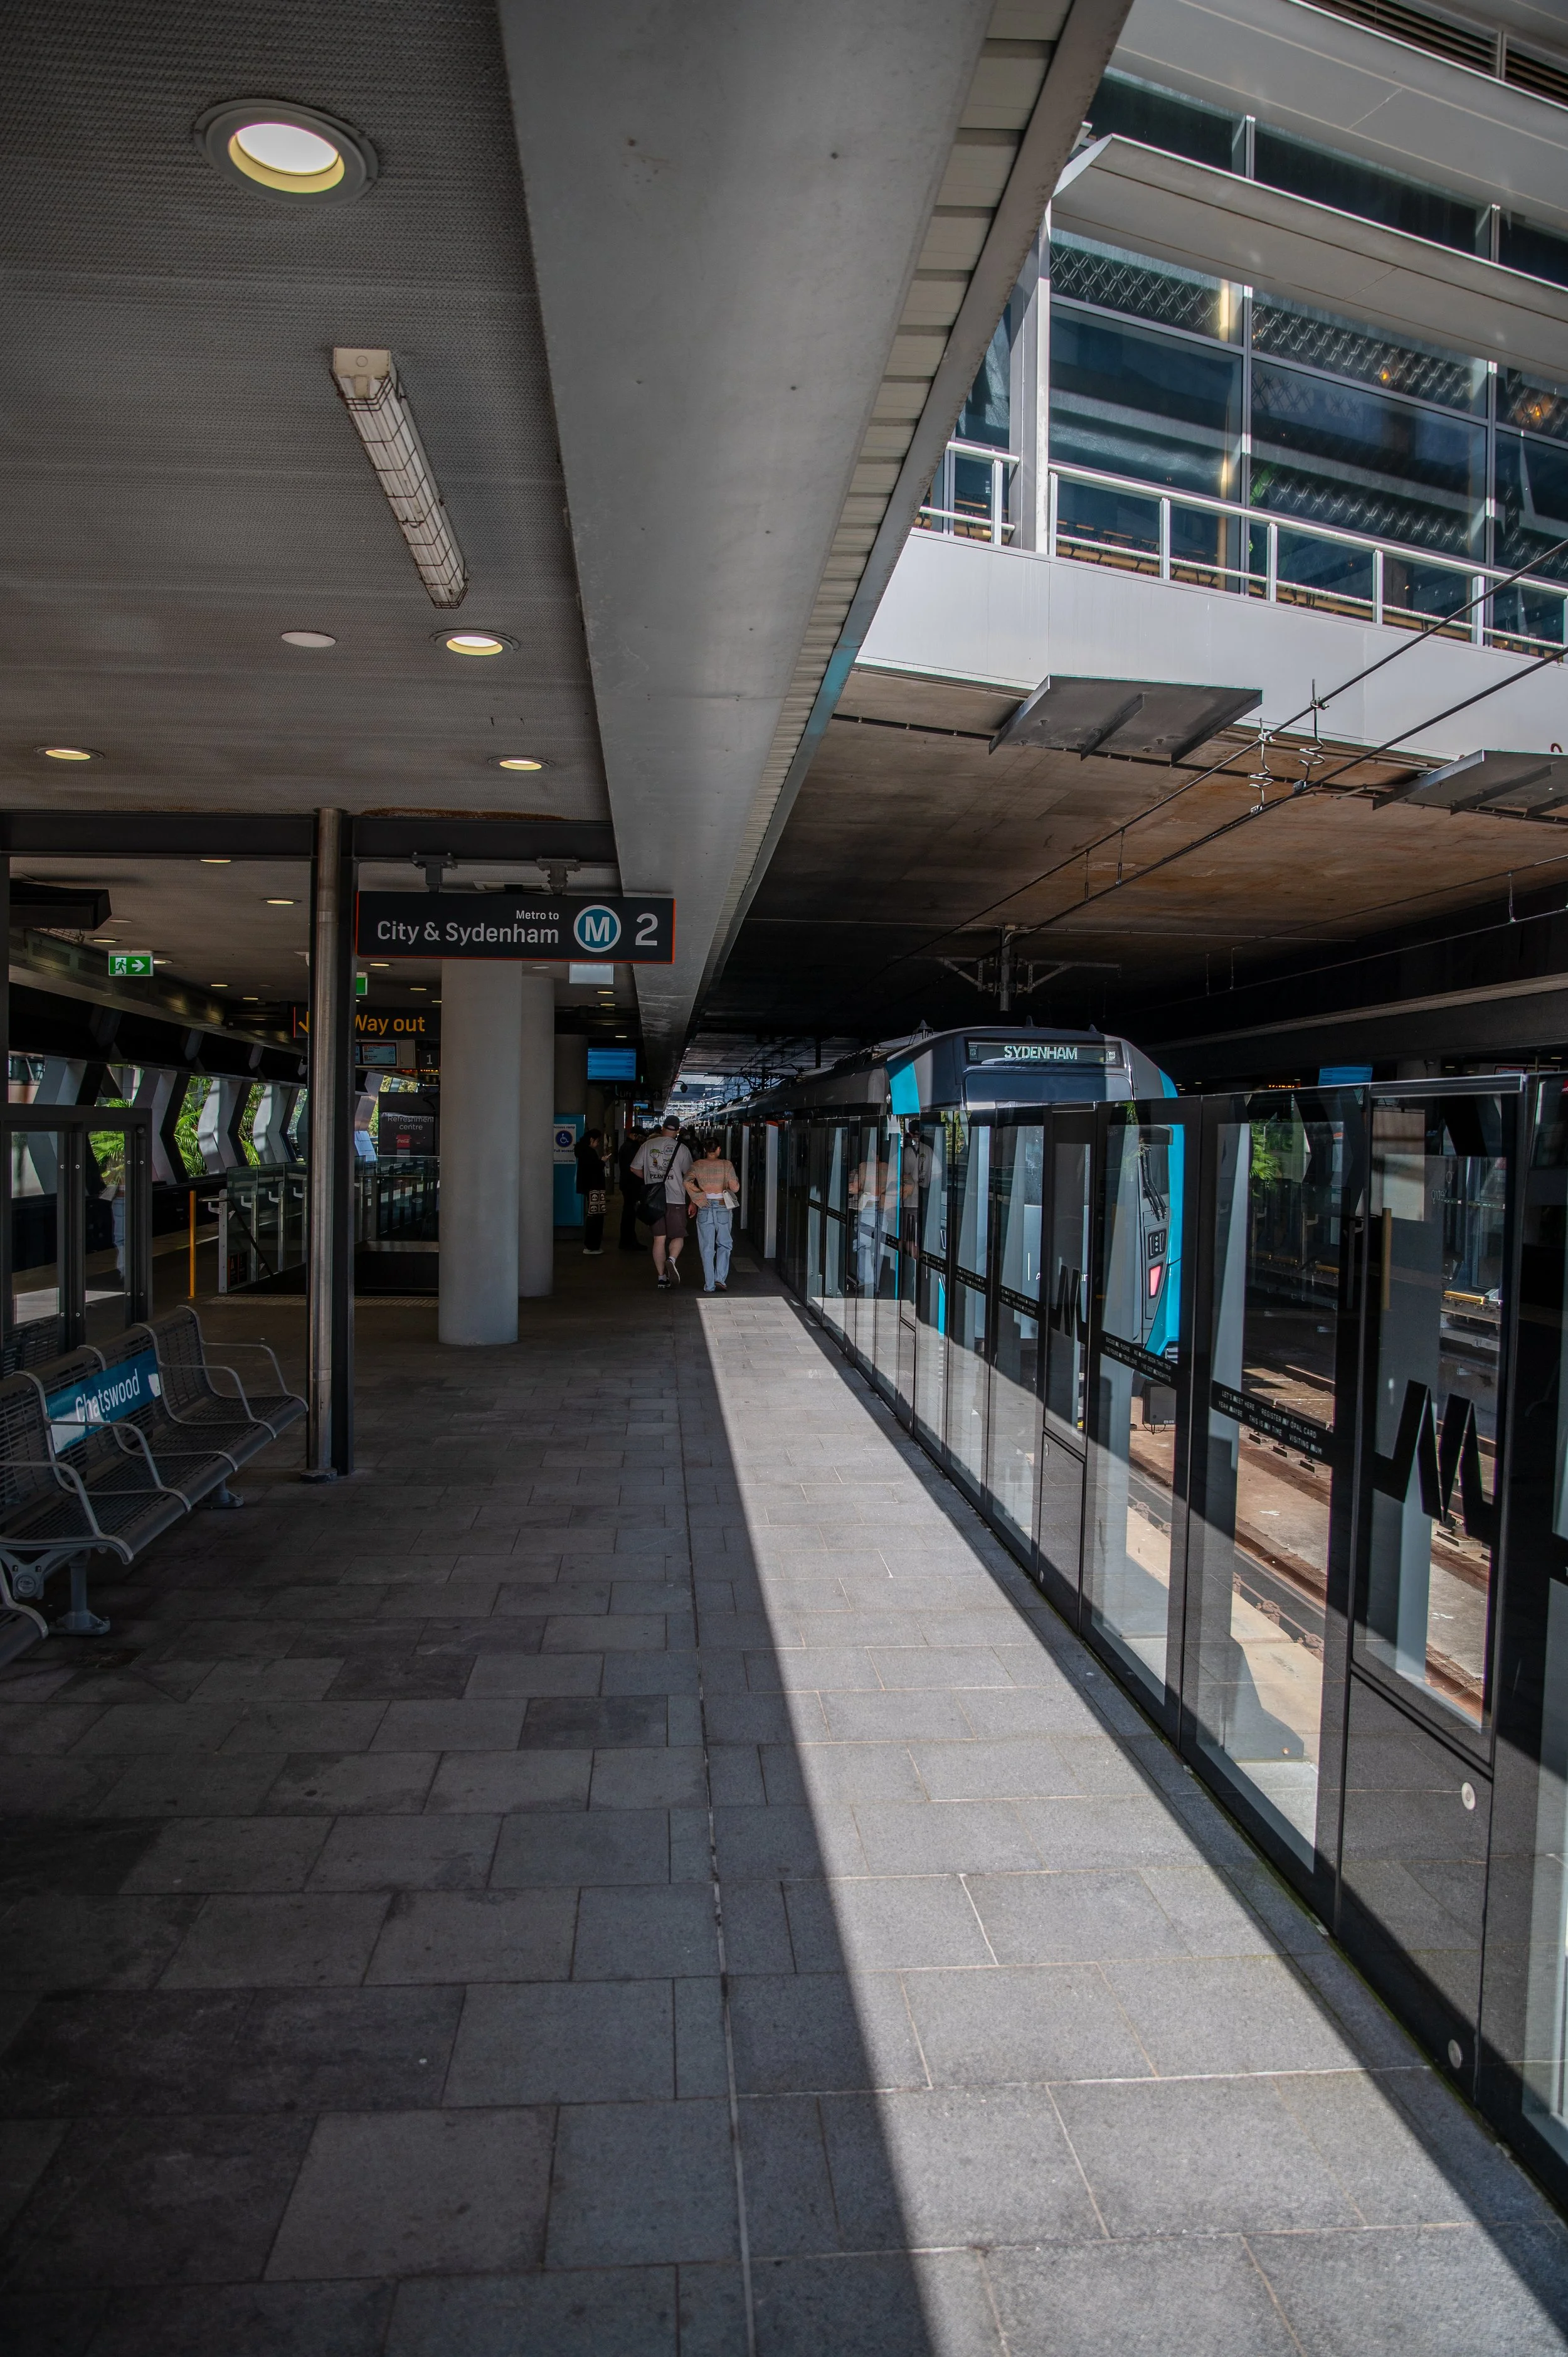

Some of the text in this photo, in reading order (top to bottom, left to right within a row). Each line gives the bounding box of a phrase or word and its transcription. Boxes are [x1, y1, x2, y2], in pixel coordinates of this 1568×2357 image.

[516, 910, 559, 920] Metro to
[377, 920, 420, 945] City
[423, 921, 441, 941] &
[445, 922, 559, 946] Sydenham
[635, 913, 658, 946] 2
[355, 1014, 426, 1036] Way out
[426, 1054, 433, 1065] 1
[1004, 1045, 1078, 1060] SYDENHAM
[75, 1368, 140, 1422] Chatswood
[1217, 1400, 1228, 1410] YEAH
[1228, 1405, 1243, 1417] MAYBE
[1249, 1414, 1259, 1425] THIS
[1272, 1425, 1283, 1437] TIME
[1288, 1434, 1310, 1449] VISITING
[1310, 1443, 1322, 1455] MUM
[1221, 1390, 1316, 1439] LET'S MEET HERE REGISTER MY OPAL CARD
